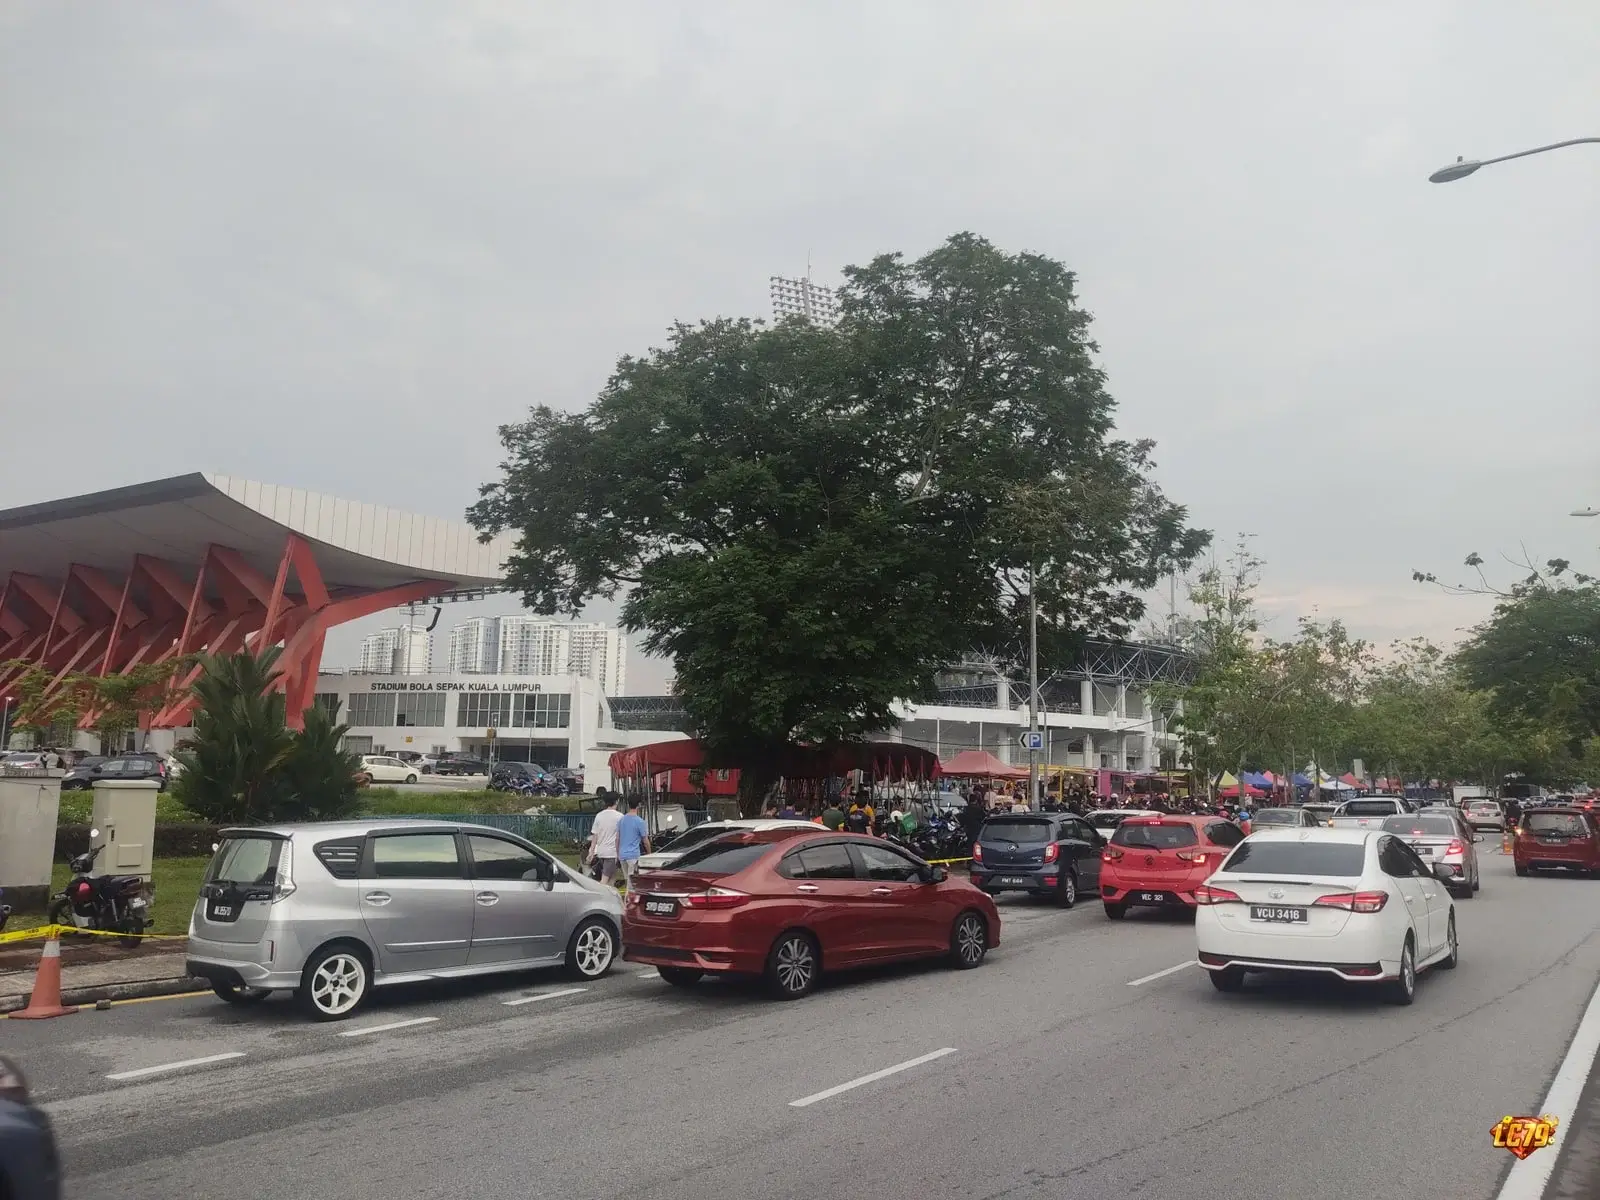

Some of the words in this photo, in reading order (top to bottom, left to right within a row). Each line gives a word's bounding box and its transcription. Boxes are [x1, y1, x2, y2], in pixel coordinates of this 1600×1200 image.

[370, 682, 407, 691] STADIUM
[409, 682, 433, 691] BOLA
[436, 682, 465, 691] SEPAK
[468, 683, 499, 691] KUALA
[502, 683, 542, 692] LUMPUR
[1030, 734, 1041, 747] P
[1141, 893, 1152, 901] VEC
[1256, 907, 1275, 919] VCU
[1276, 908, 1300, 920] 3416
